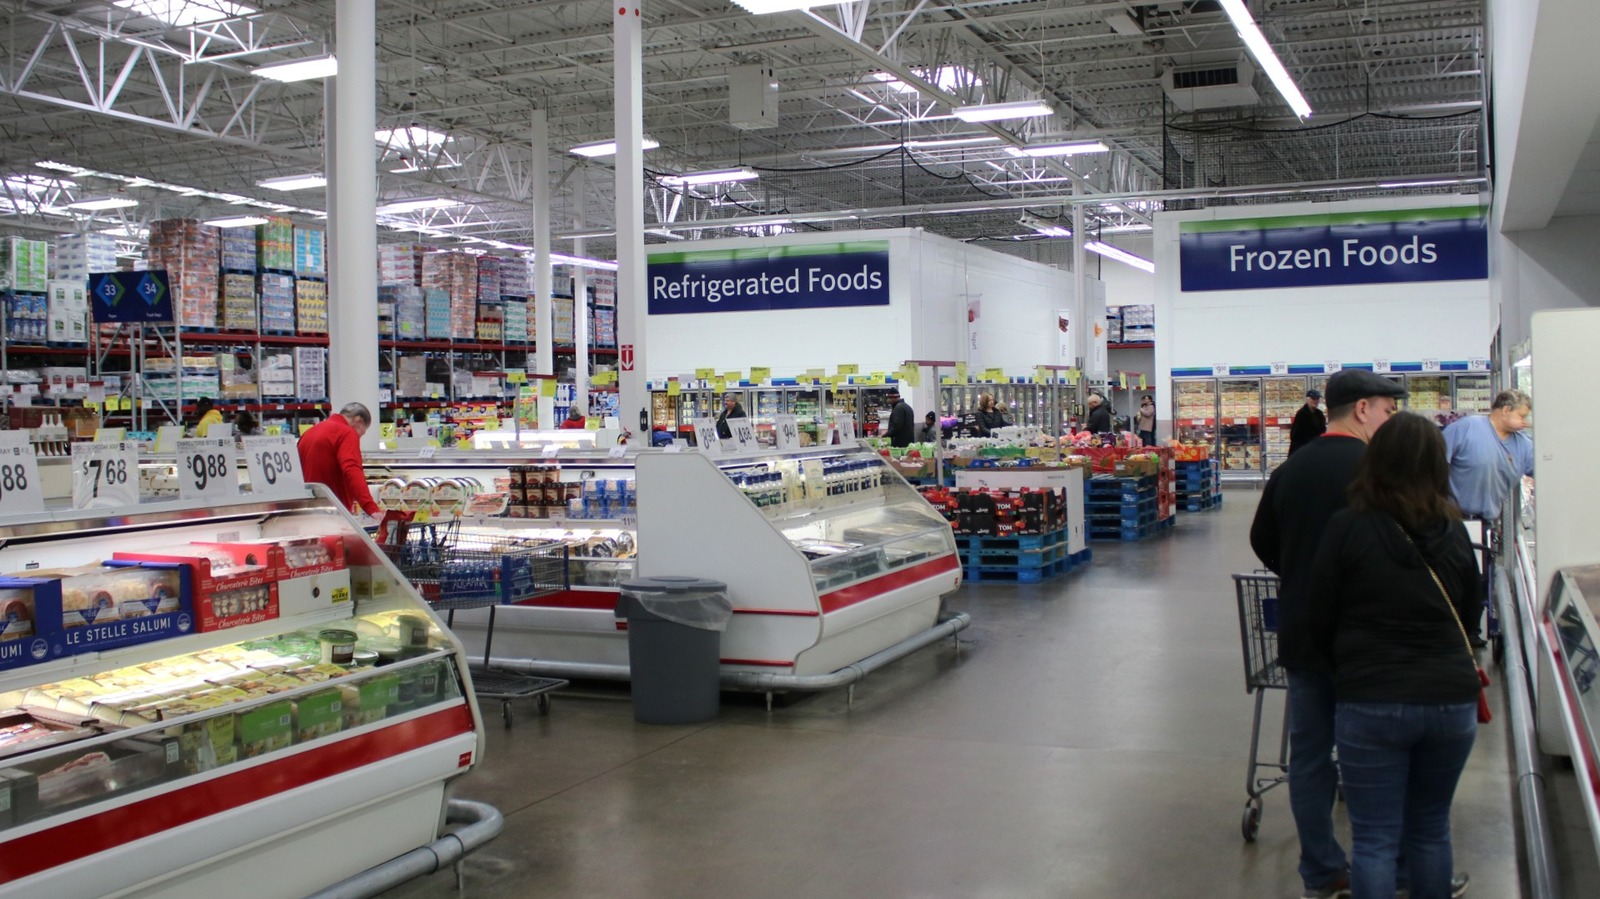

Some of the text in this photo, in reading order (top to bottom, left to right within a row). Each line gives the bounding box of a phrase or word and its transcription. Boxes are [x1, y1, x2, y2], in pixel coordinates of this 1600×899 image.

[1230, 235, 1438, 272] Frozen Foods
[104, 284, 116, 297] 33
[144, 282, 157, 295] 34
[653, 264, 882, 302] Refrigerated Foods
[0, 463, 28, 492] 88
[215, 580, 248, 592] Charcuterie
[249, 577, 263, 587] Bites
[66, 631, 80, 645] LE
[86, 624, 127, 642] STELLE
[132, 617, 171, 633] SALUMI
[218, 616, 251, 629] Charcuterie
[251, 613, 266, 624] Bites
